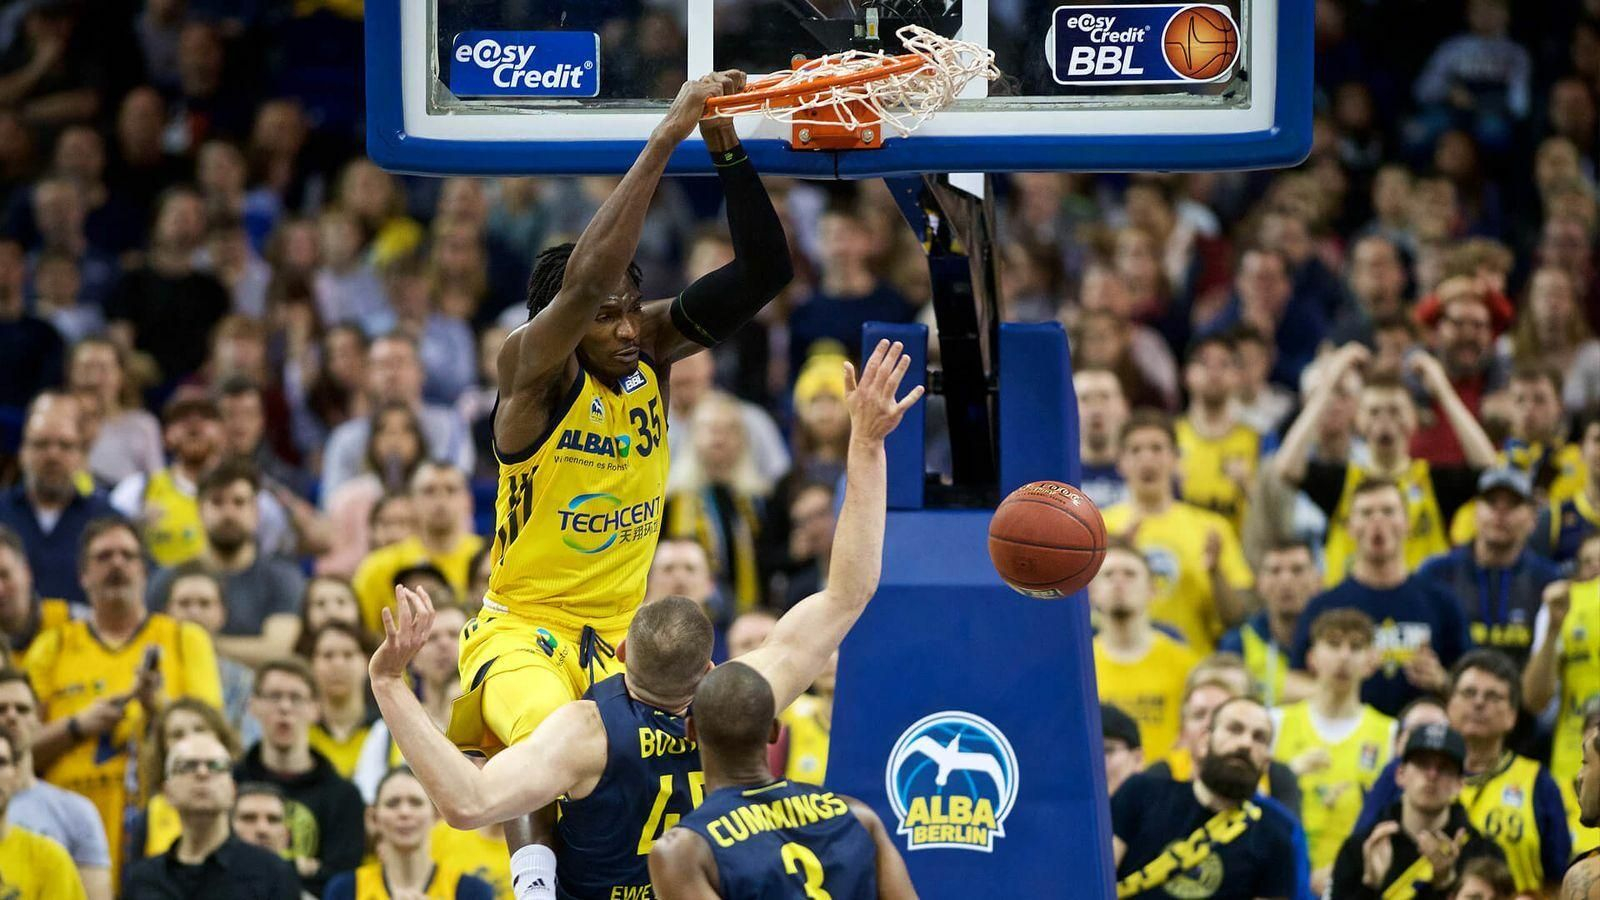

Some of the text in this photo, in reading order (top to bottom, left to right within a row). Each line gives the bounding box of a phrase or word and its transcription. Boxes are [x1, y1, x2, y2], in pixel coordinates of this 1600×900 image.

[1067, 13, 1116, 32] e@sy
[455, 39, 536, 71] e@sy
[1067, 45, 1144, 76] BBL
[629, 395, 662, 458] 35
[556, 429, 616, 458] ALBA
[564, 456, 594, 467] nennen
[607, 463, 629, 472] Rohst
[557, 495, 661, 534] TECHCENT
[636, 770, 705, 856] 4
[706, 792, 848, 848] CUMMINGS
[904, 795, 997, 829] ALBA
[913, 824, 988, 846] BERLIN
